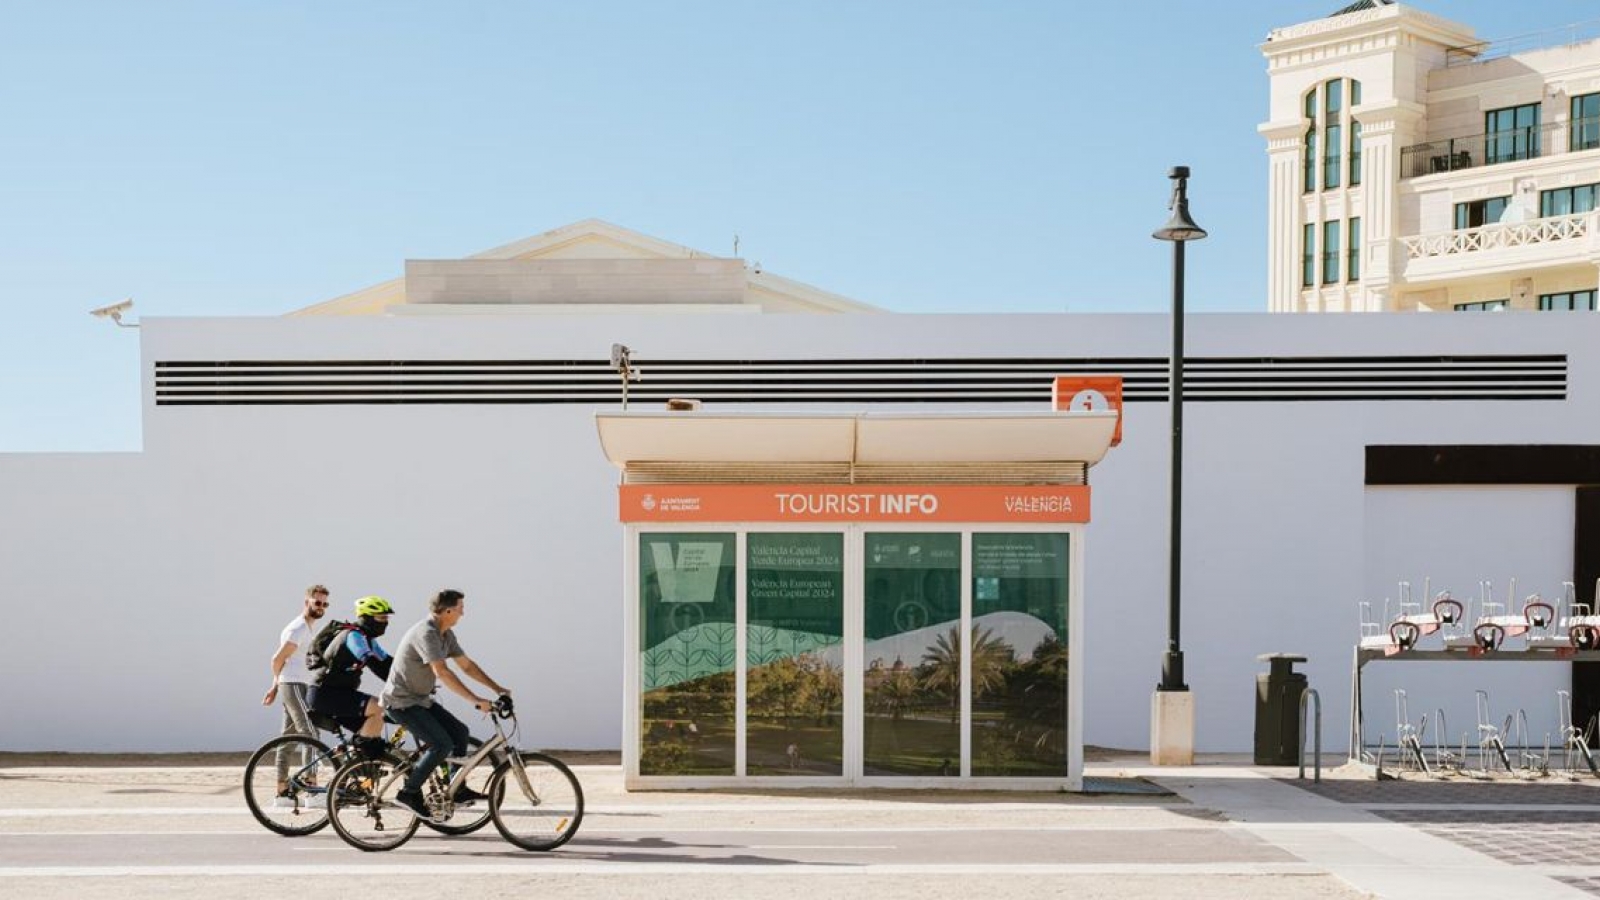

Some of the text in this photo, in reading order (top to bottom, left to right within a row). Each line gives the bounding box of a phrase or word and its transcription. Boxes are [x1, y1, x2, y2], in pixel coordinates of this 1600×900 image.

[775, 494, 938, 513] TOURIST INFO
[789, 546, 821, 557] Capital
[816, 556, 839, 565] 2024
[789, 578, 832, 589] European
[751, 588, 835, 599] Green Capital 2024
